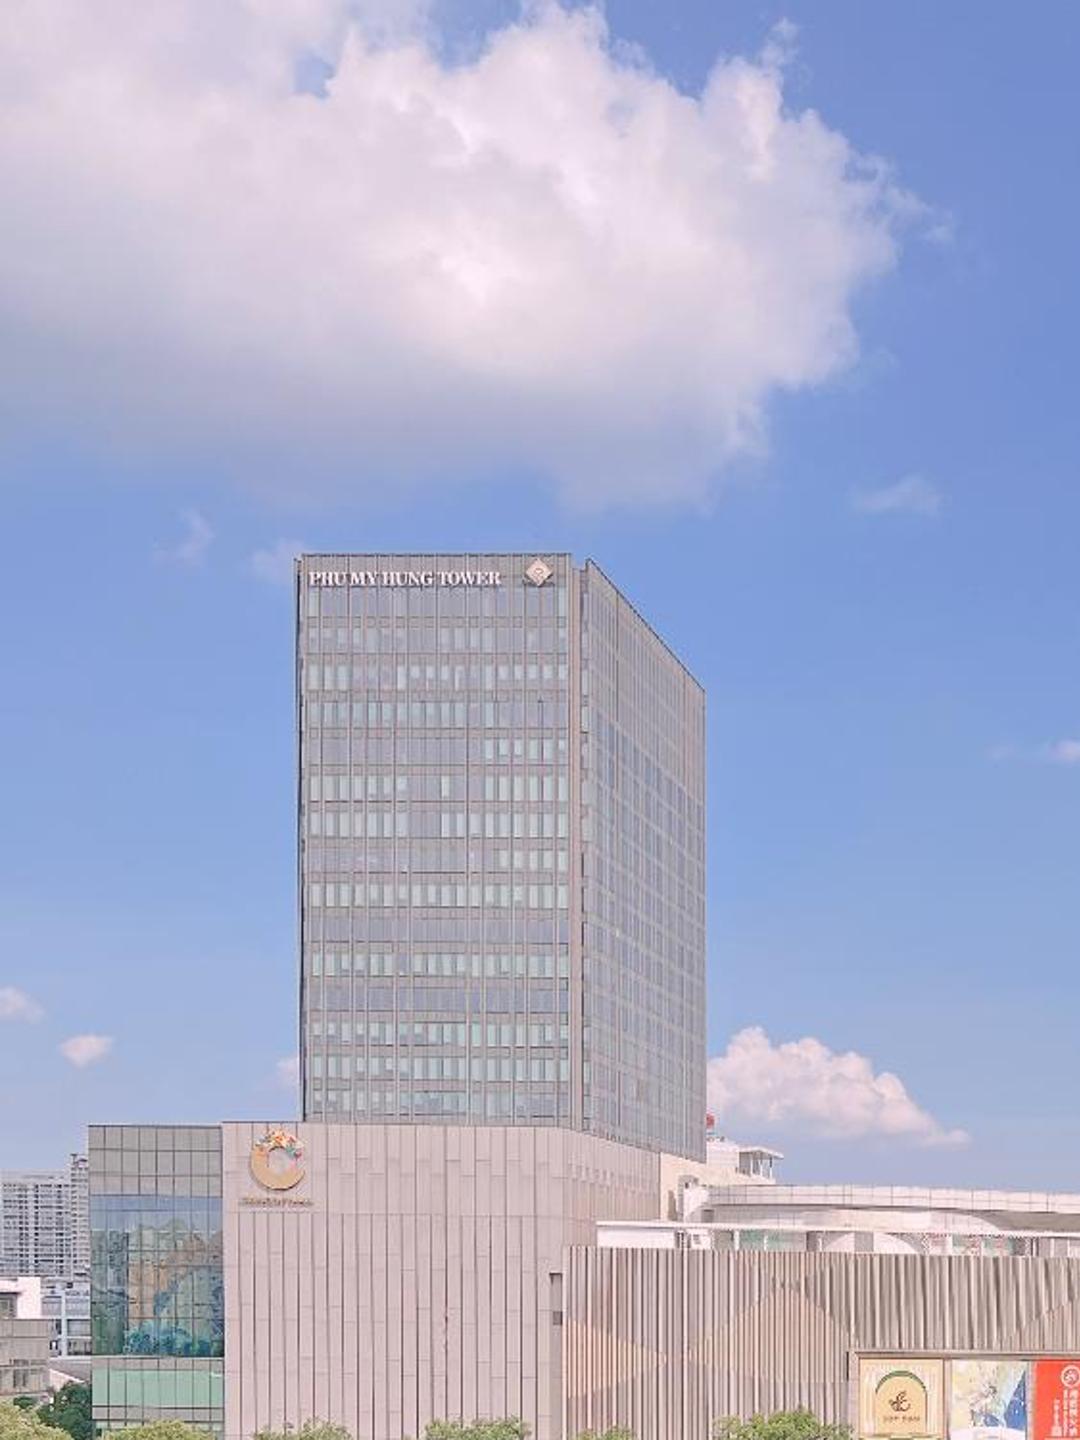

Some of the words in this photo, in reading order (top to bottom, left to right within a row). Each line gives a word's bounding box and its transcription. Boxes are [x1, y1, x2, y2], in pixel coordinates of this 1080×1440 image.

[309, 571, 348, 586] PHU
[350, 571, 377, 586] MY
[382, 571, 433, 586] HUNG
[438, 571, 501, 586] TOWER
